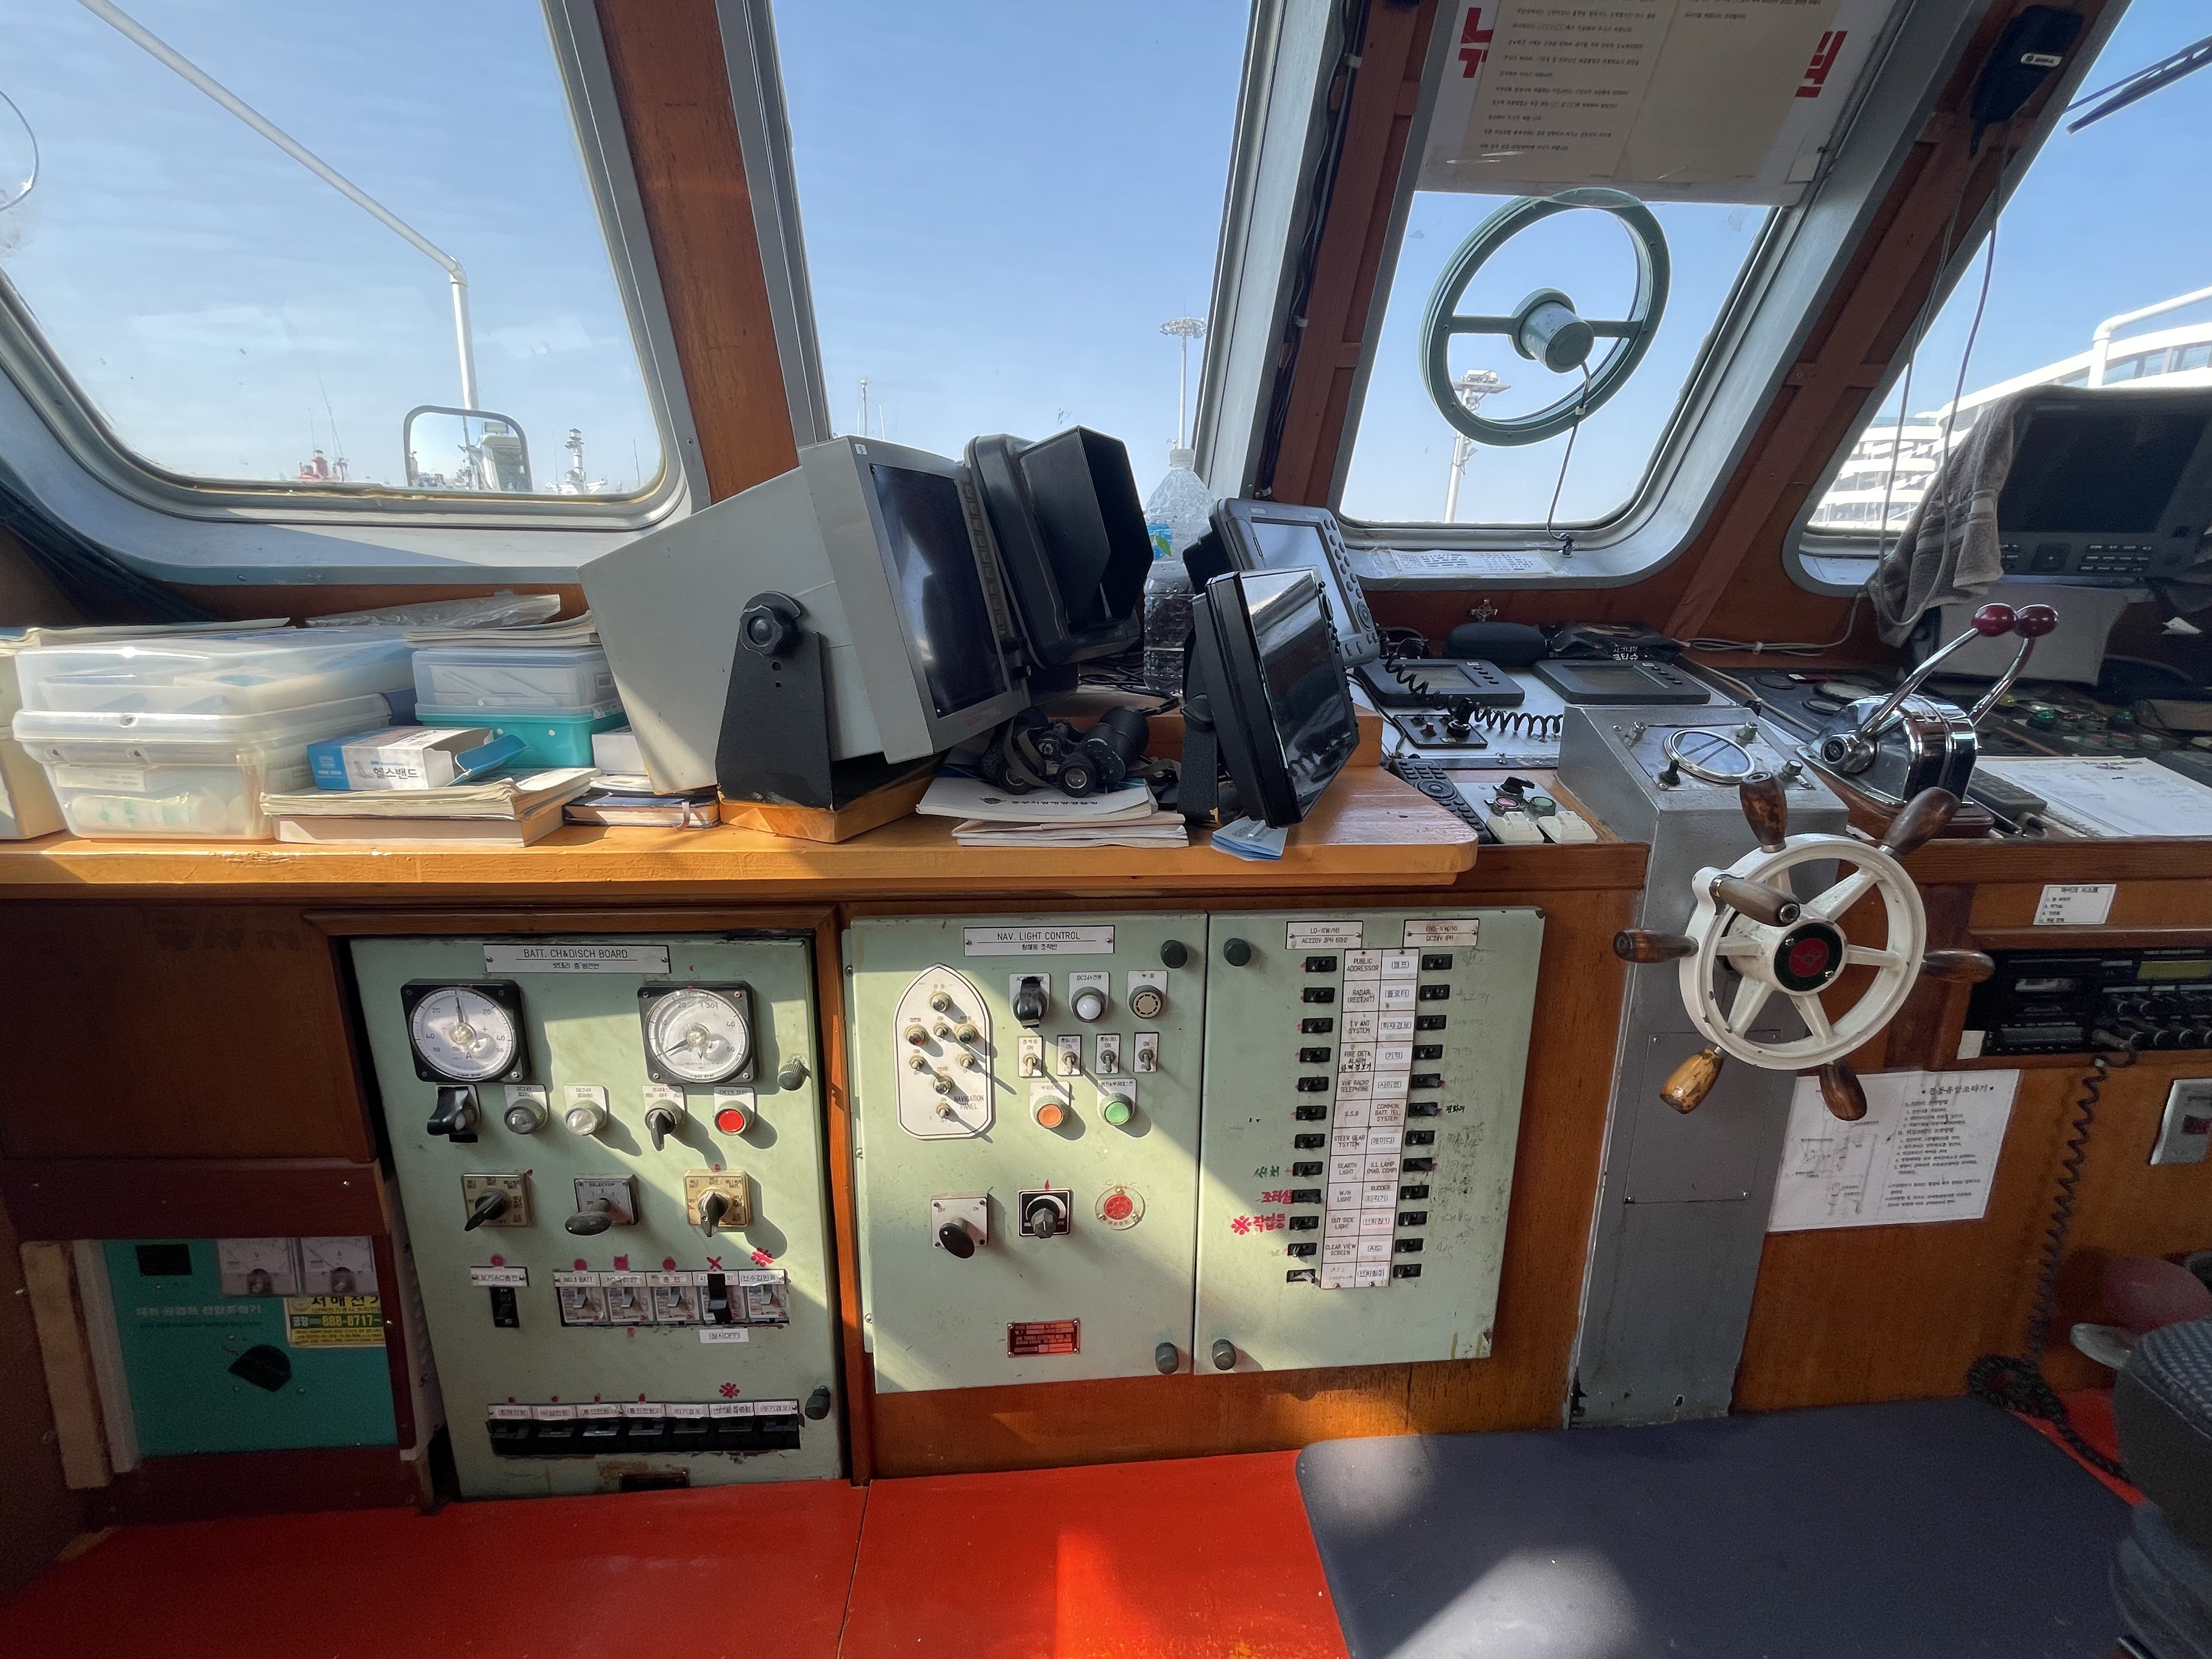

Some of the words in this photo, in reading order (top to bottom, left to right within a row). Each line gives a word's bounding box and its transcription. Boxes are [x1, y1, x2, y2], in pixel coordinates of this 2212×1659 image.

[857, 445, 865, 454] S
[373, 767, 419, 780] 헬스밴드
[997, 931, 1016, 941] NAV.
[1019, 931, 1042, 941] LIGHT
[1045, 930, 1081, 941] CONTROL
[523, 949, 548, 958] BATT.
[550, 949, 596, 959] CH&DISCH
[599, 949, 629, 959] BOARD
[953, 1094, 984, 1103] NAVIGATION
